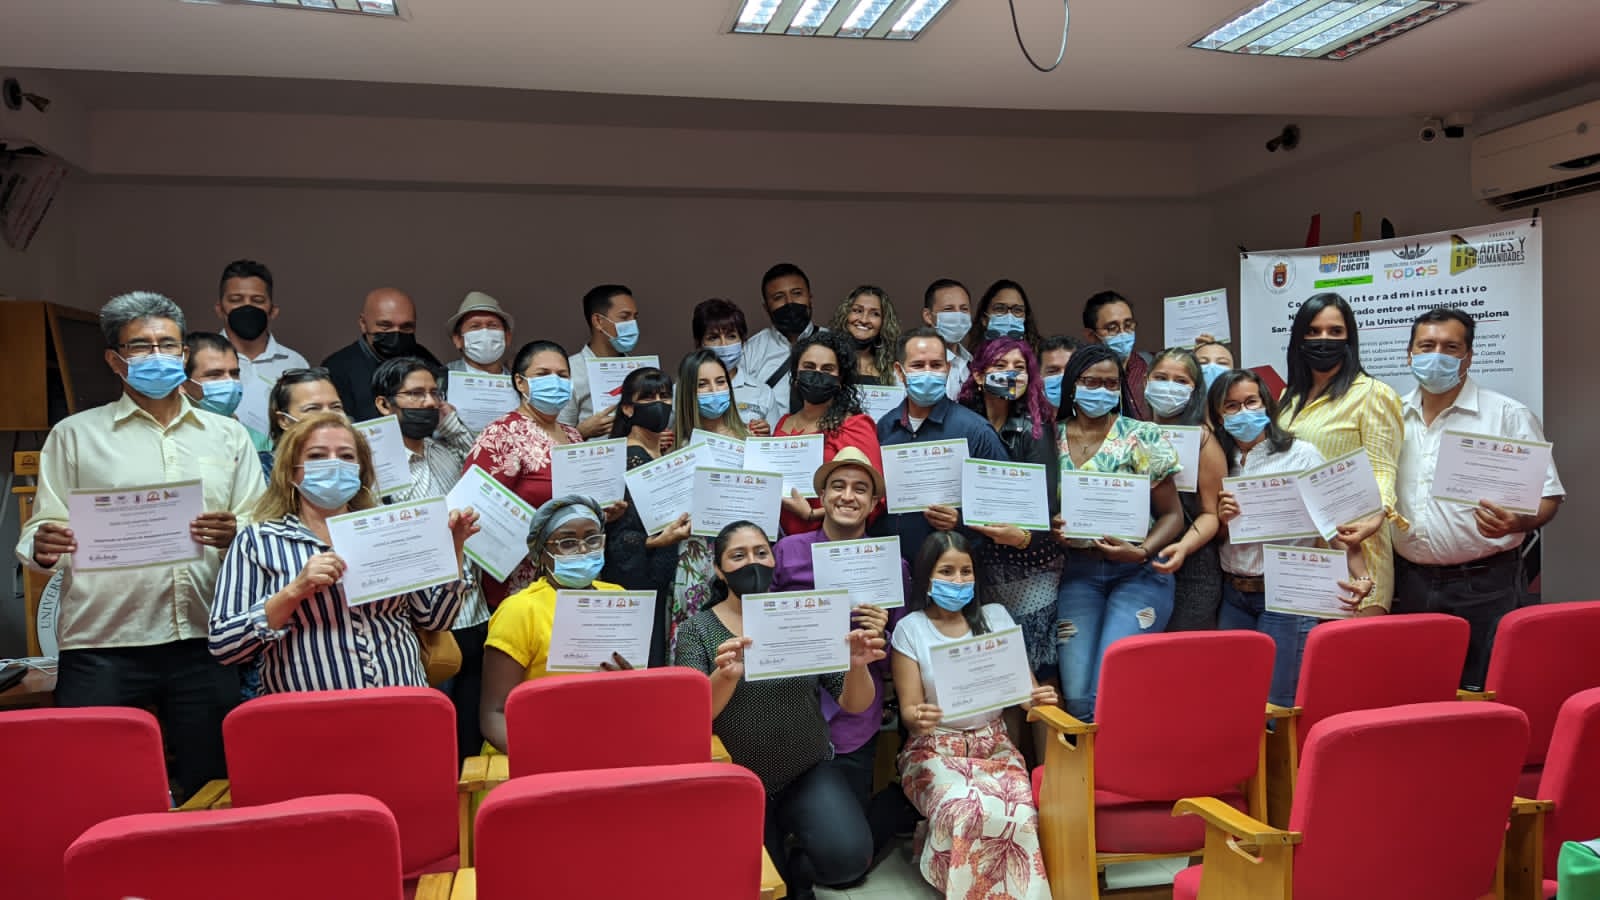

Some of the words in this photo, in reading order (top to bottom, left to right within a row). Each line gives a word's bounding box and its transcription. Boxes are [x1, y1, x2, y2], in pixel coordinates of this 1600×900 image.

[1480, 242, 1514, 254] ARTES
[1519, 236, 1526, 253] Y
[1477, 250, 1525, 265] HUMANIDADES
[1384, 264, 1438, 280] TODOS
[1349, 285, 1487, 304] interadministrativo
[1377, 305, 1403, 314] entre
[1405, 303, 1415, 311] el
[1417, 300, 1468, 311] municipio
[1358, 320, 1363, 328] y
[1470, 310, 1510, 321] mplona
